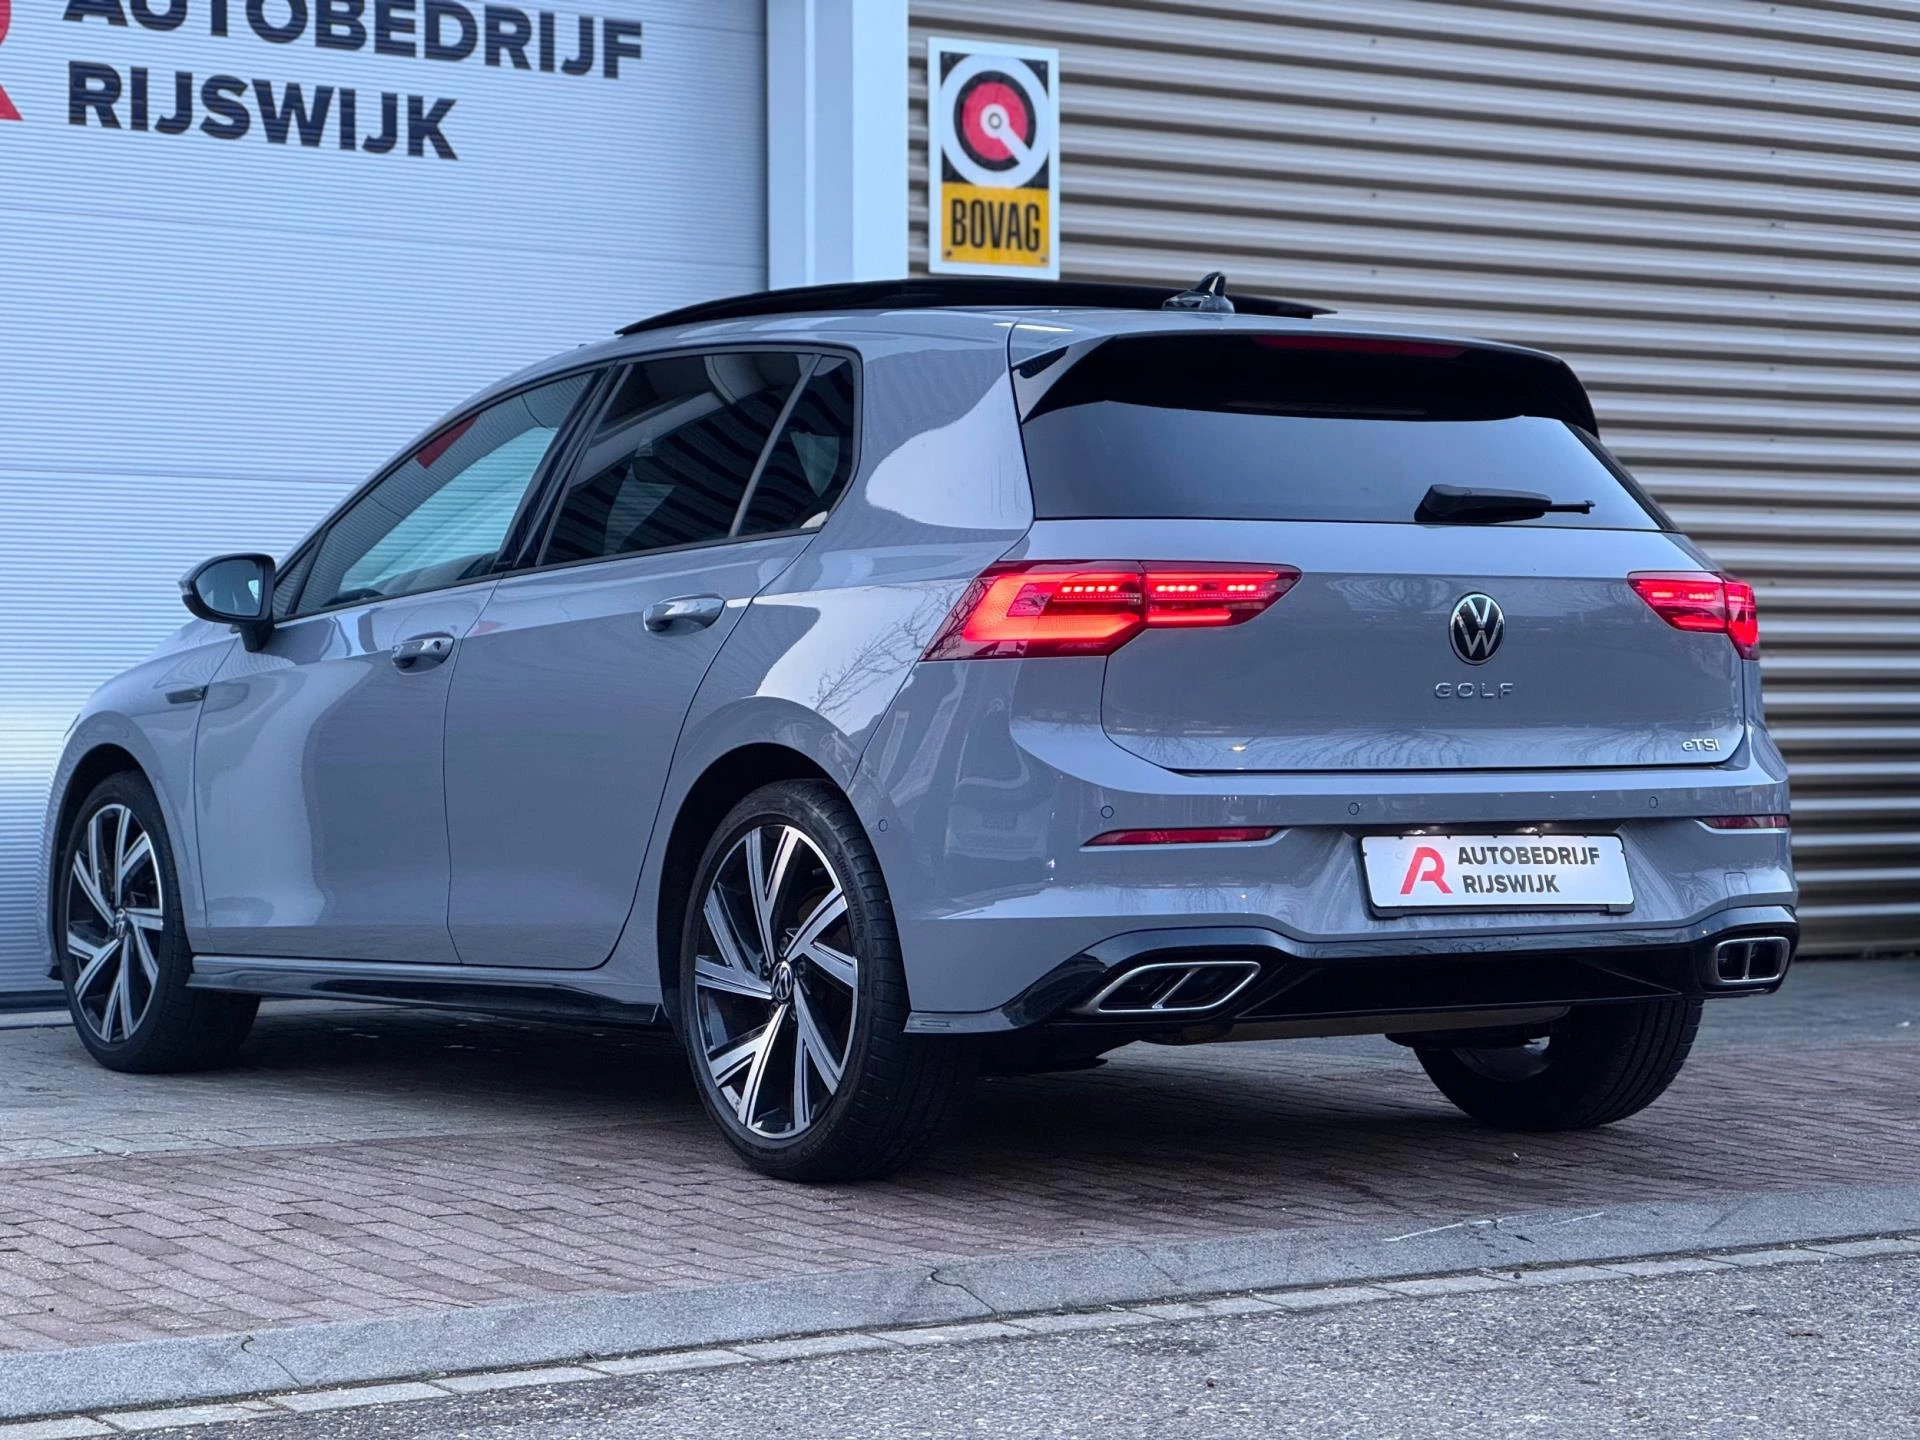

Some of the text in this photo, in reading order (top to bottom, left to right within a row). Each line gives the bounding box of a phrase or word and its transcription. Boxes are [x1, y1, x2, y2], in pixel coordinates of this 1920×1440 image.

[68, 60, 458, 160] RIJSWIJK
[951, 198, 1040, 252] BOVAG
[1434, 682, 1515, 698] GOLF
[1682, 737, 1721, 751] eTSI
[1457, 846, 1601, 865] AUTOBEDRIJF
[1462, 874, 1560, 894] RIJSWIJK
